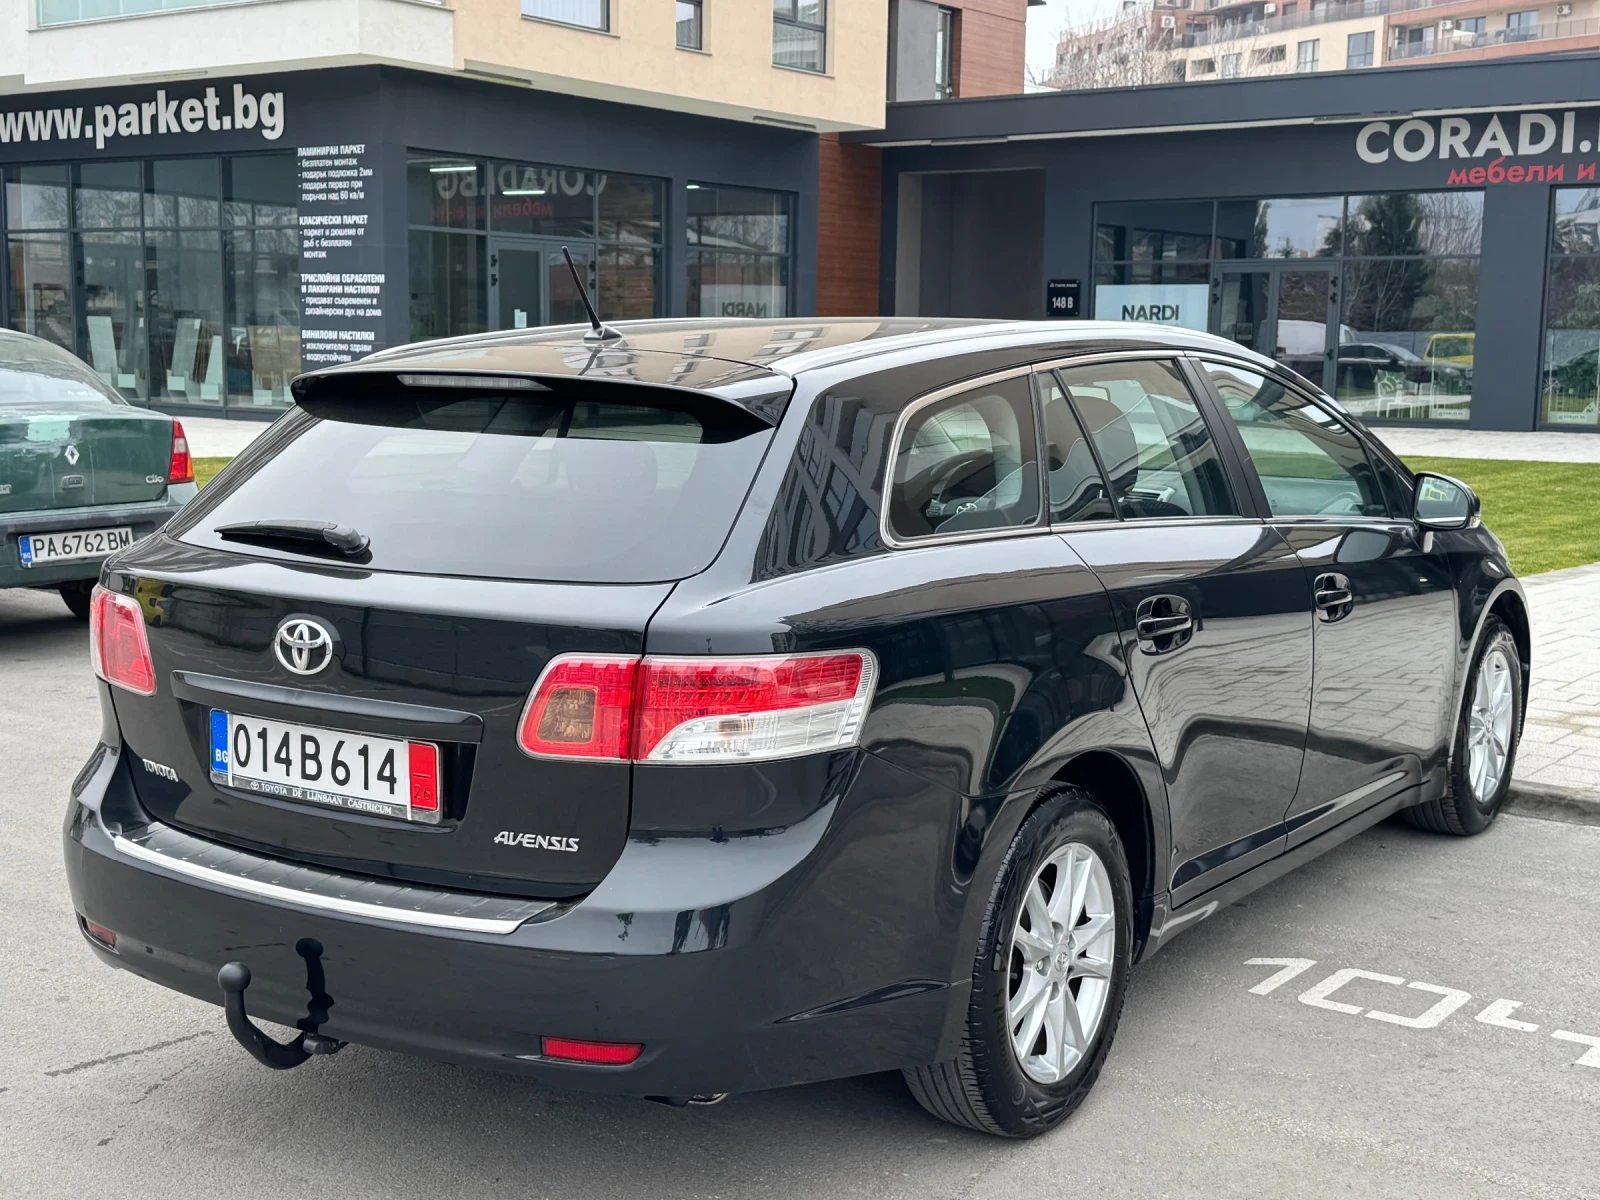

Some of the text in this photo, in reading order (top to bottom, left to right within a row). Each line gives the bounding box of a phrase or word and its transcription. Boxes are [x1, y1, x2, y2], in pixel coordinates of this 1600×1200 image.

[0, 84, 285, 149] www.parket.bg
[1356, 111, 1600, 164] CORADI.
[297, 144, 365, 157] ЛАМИНИРАН ПАРКЕТ
[302, 158, 358, 168] безплатен монтаж
[1447, 157, 1596, 185] мебели и
[350, 180, 363, 190] при
[340, 190, 349, 200] 60
[299, 214, 368, 226] КЛАСИЧЕСКИ ПАРКЕТ
[303, 228, 324, 238] паркет
[357, 227, 365, 235] от
[320, 237, 352, 248] безплатен
[303, 250, 327, 259] монтаж
[300, 272, 385, 284] ТРИСЛОЙНИ ОБРАБОТЕНИ
[301, 284, 381, 295] И ЛАКИРАНИ НАСТИЛКИ
[1052, 296, 1067, 309] 148
[356, 308, 365, 316] на
[365, 308, 382, 317] дома
[1122, 304, 1180, 321] NARDI
[301, 329, 375, 341] ВИНИЛОВИ НАСТИЛКИ
[145, 474, 165, 484] Clio
[215, 748, 229, 764] BG
[233, 723, 398, 796] 014B614
[142, 758, 179, 783] TOYOTA
[413, 783, 431, 801] 26
[261, 782, 288, 796] TOYOTA
[292, 789, 302, 798] DE
[347, 797, 392, 815] CASTRICUM
[493, 830, 580, 852] AVENSIS
